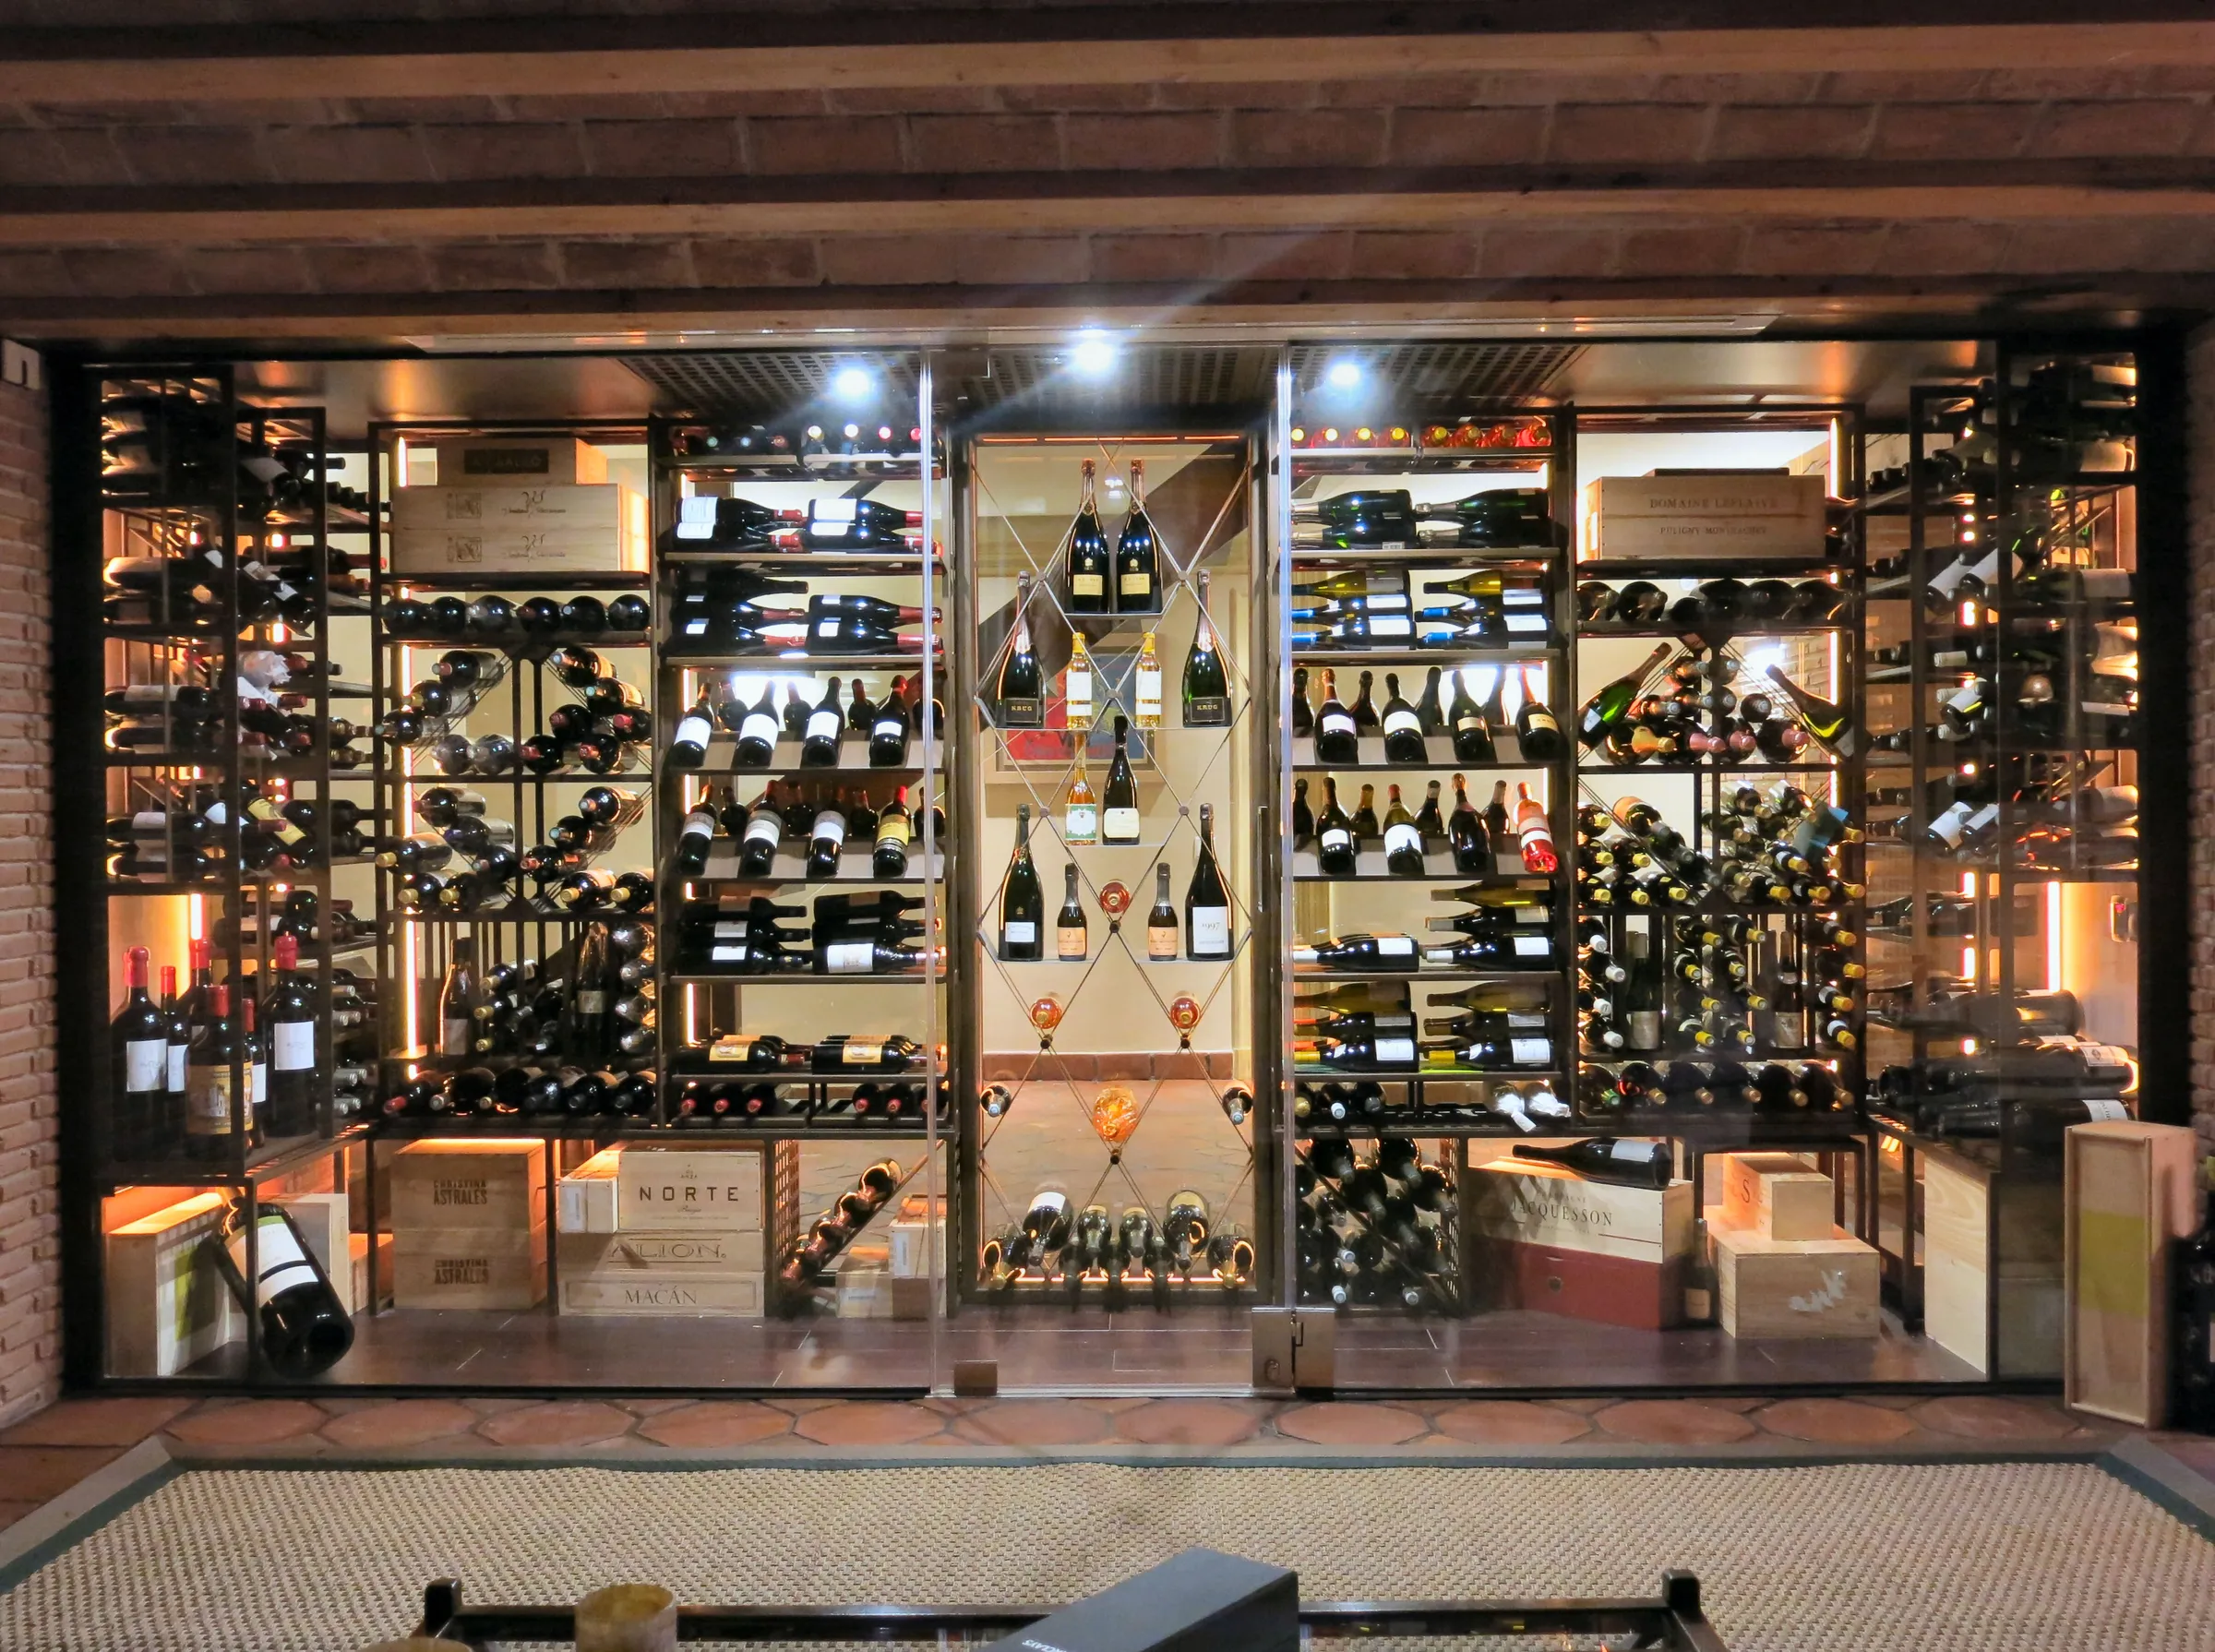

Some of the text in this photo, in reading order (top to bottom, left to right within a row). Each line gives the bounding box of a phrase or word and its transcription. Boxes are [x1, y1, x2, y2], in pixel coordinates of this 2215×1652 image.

[1649, 497, 1709, 509] DOMAINE
[434, 1189, 488, 1205] ASTRALES
[640, 1186, 738, 1202] NORTE
[1511, 1200, 1613, 1227] JACQUESSON
[625, 1285, 698, 1305] MACÁN
